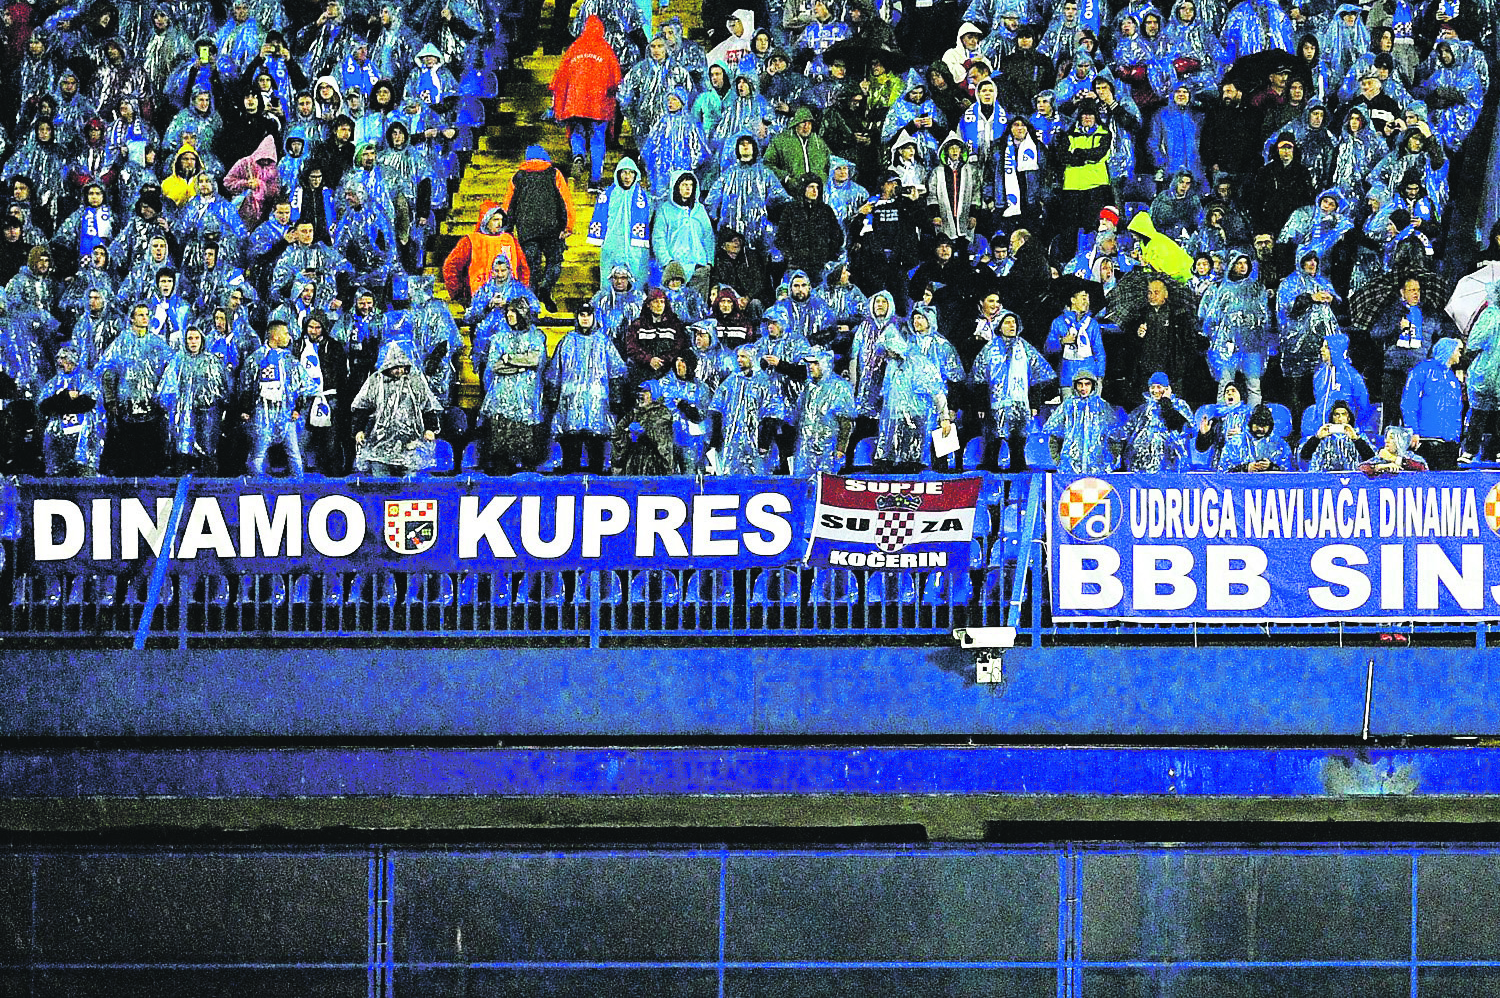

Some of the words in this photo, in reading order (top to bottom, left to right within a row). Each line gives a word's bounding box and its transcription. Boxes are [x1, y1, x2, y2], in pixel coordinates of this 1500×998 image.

[33, 494, 367, 562] DINAMO
[459, 492, 793, 560] KUPRES
[819, 513, 871, 532] SU
[920, 516, 965, 535] ZA
[1130, 487, 1238, 540] UDRUGA
[1244, 477, 1373, 540] NAVIJAČA
[1379, 487, 1480, 539] DINAMA
[829, 548, 948, 569] KOČERIN
[1058, 543, 1271, 611] BBB
